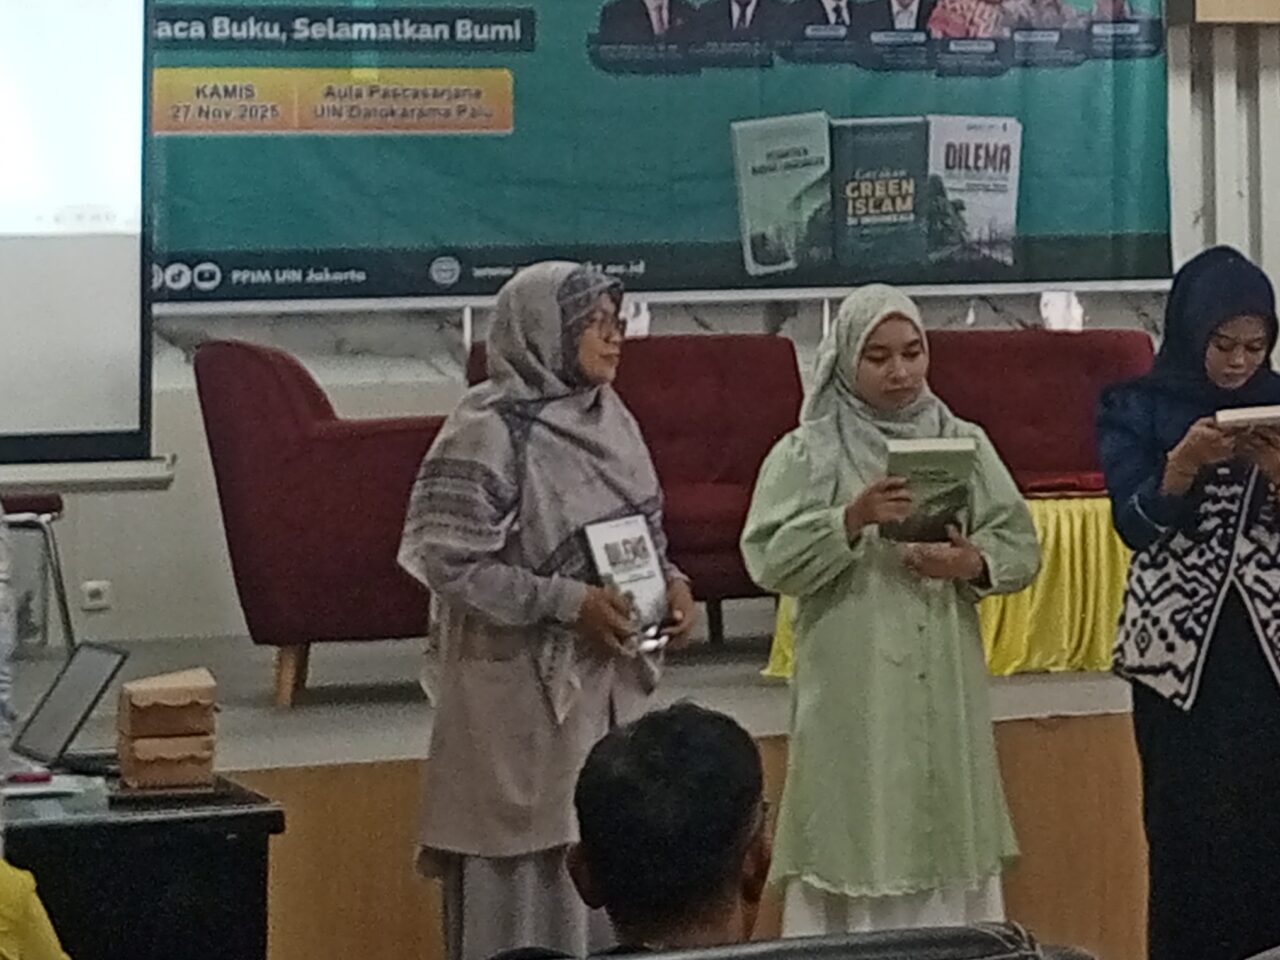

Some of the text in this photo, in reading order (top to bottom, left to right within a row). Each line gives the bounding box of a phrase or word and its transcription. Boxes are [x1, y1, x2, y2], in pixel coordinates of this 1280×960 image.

[153, 16, 522, 46] aca Buku, Selamatkan Bumi
[195, 83, 256, 101] KAMIS
[323, 84, 364, 101] Aula
[170, 104, 191, 120] 27
[238, 104, 280, 120] 2025
[944, 141, 1012, 174] DILEMA
[845, 177, 916, 199] GREEN
[846, 194, 915, 217] ISLAM
[231, 268, 272, 285] PPIM
[305, 267, 367, 284] Jakarta
